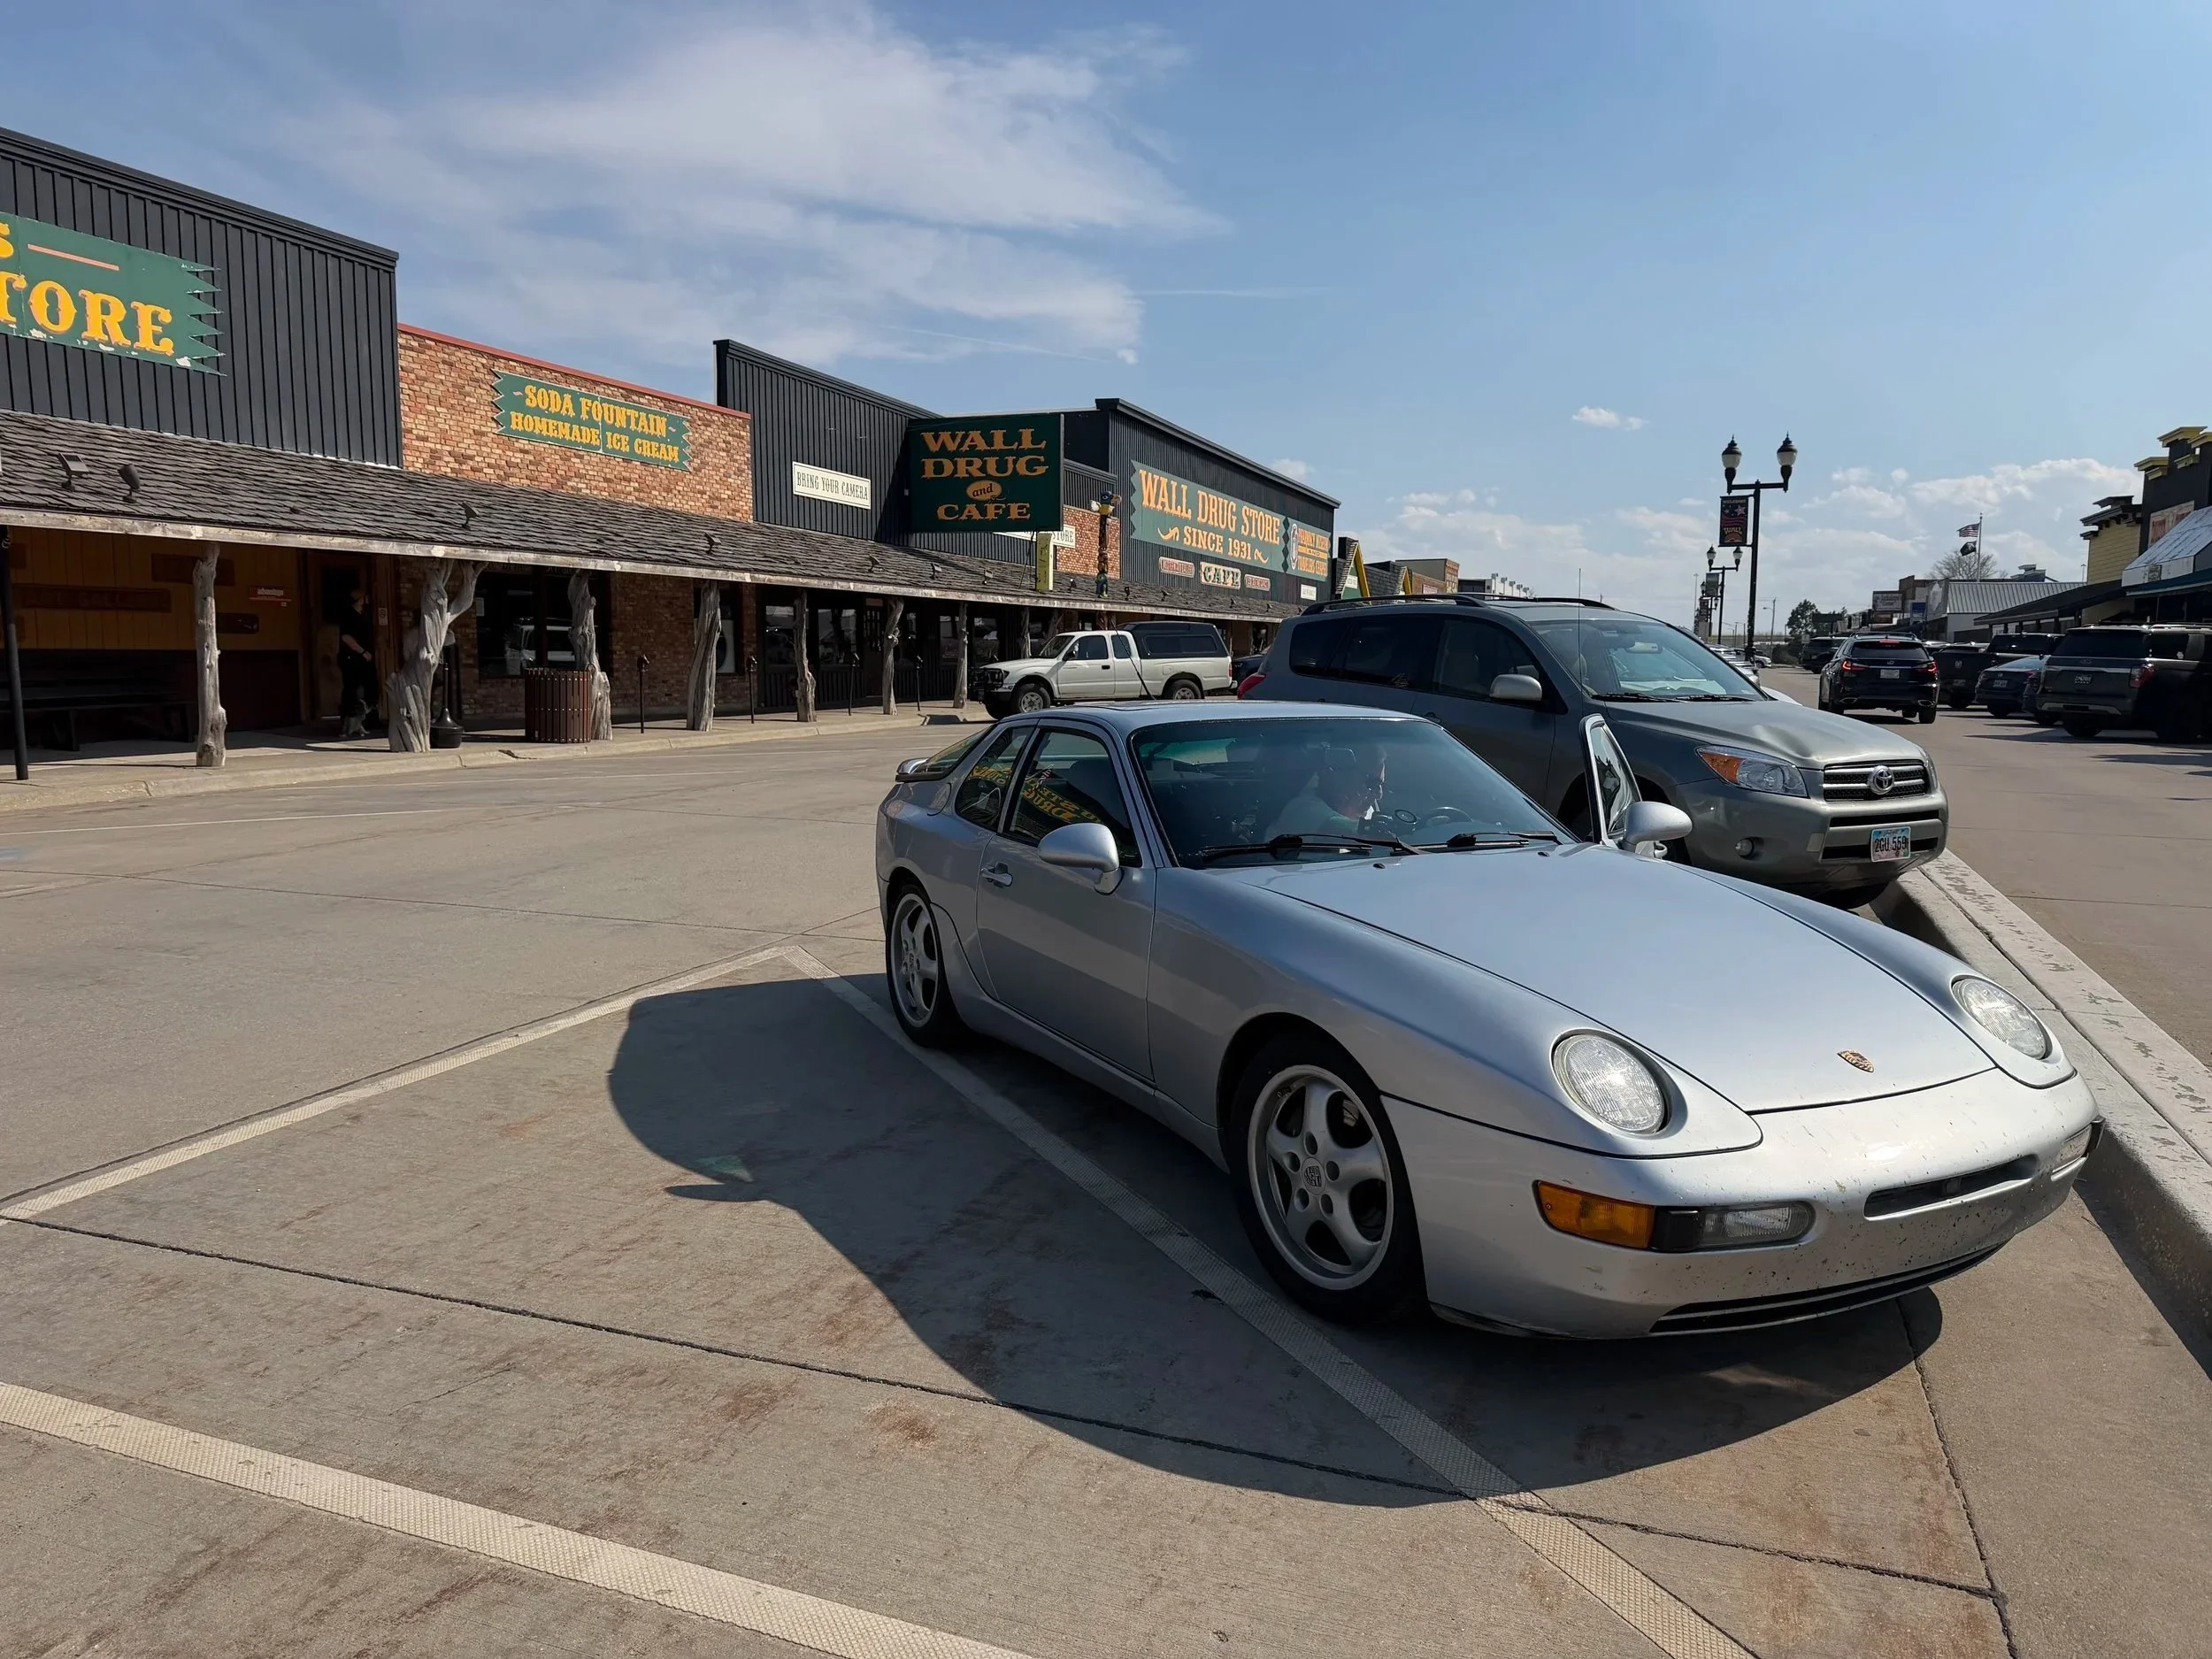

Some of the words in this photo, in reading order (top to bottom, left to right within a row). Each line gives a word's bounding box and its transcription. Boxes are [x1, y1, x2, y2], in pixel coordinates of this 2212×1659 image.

[524, 384, 575, 418] SODA
[580, 396, 667, 437] FOUNTAIN
[510, 411, 601, 446] HOMEMADE
[605, 431, 630, 452] ICE
[634, 437, 680, 463] CREAM
[920, 428, 1047, 452] WALL
[920, 455, 1048, 479] DRUG
[796, 472, 819, 490] BRING
[821, 477, 841, 495] YOUR
[841, 480, 869, 502] CAMERA
[972, 483, 994, 498] and
[935, 503, 1032, 521] CAFE
[1138, 469, 1192, 520] WALL
[1196, 489, 1237, 533] DRUG
[1240, 504, 1281, 546] STORE
[1183, 525, 1224, 553] SINCE
[1227, 538, 1252, 560] 1931
[1202, 565, 1240, 587] CAFE
